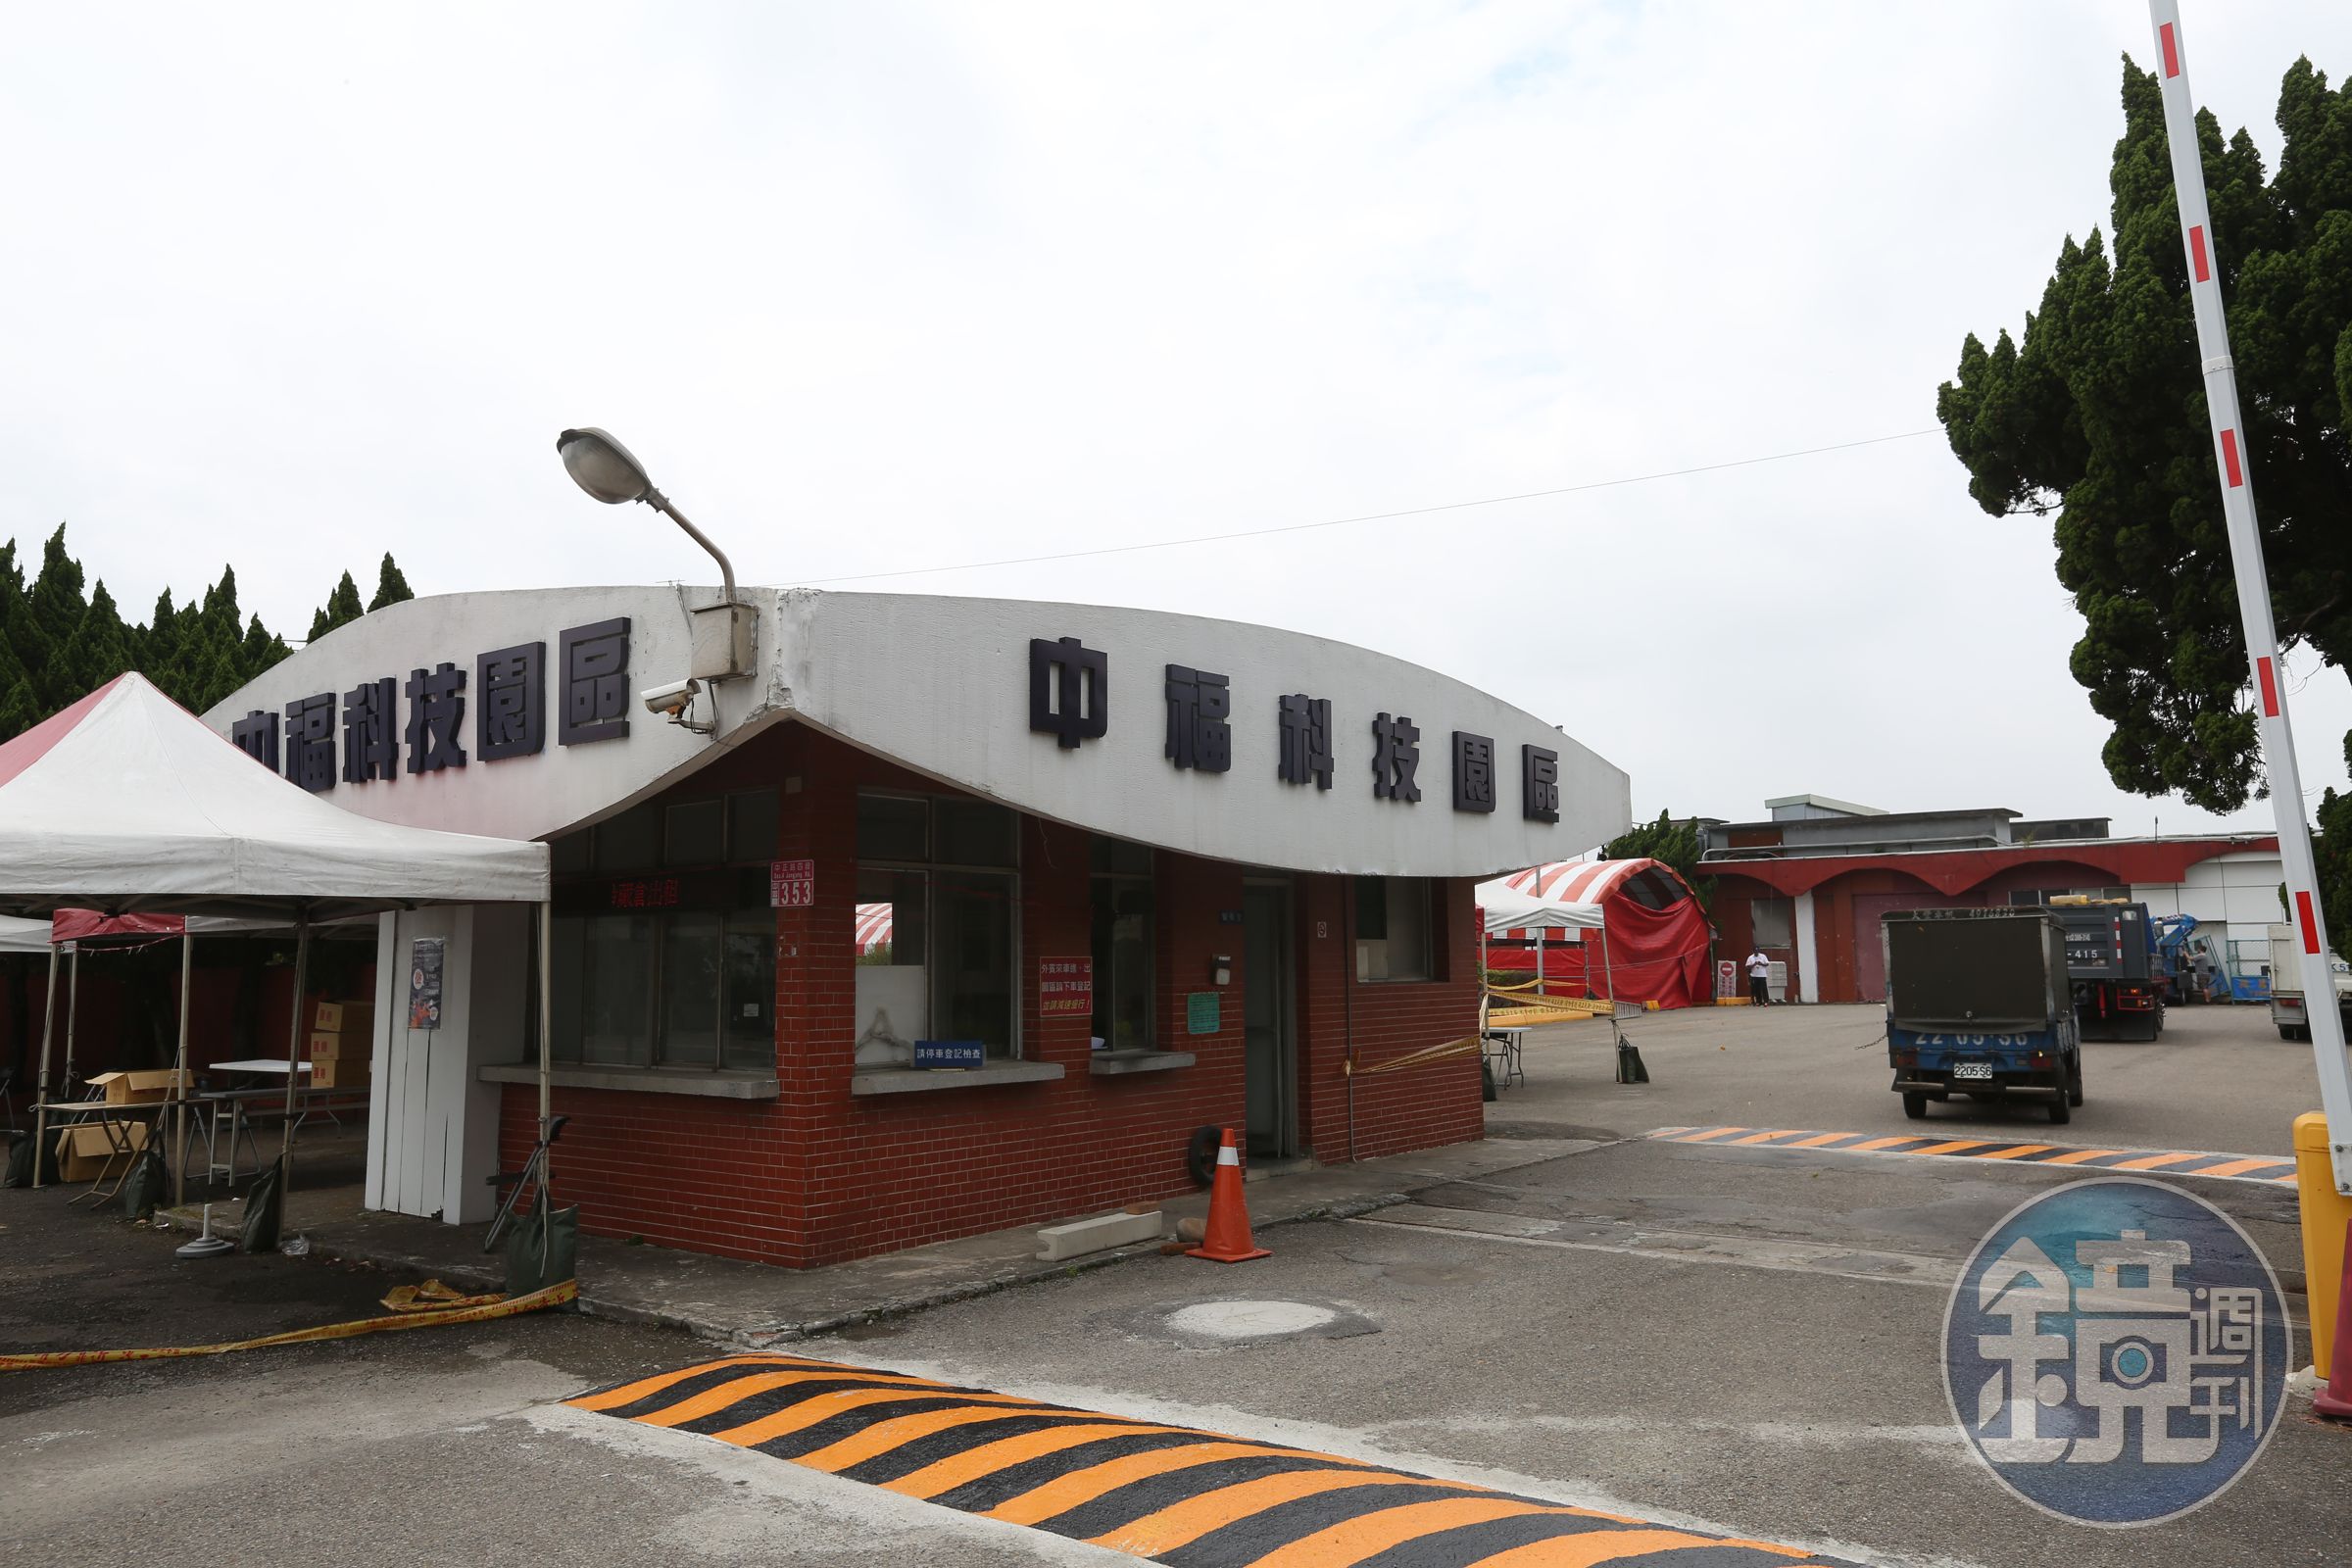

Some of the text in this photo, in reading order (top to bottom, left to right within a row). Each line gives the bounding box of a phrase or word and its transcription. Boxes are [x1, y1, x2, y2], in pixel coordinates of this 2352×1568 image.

[1030, 637, 1559, 823] 中福科技園區
[781, 881, 810, 905] 353
[916, 1048, 981, 1059] 請停車登記檢查
